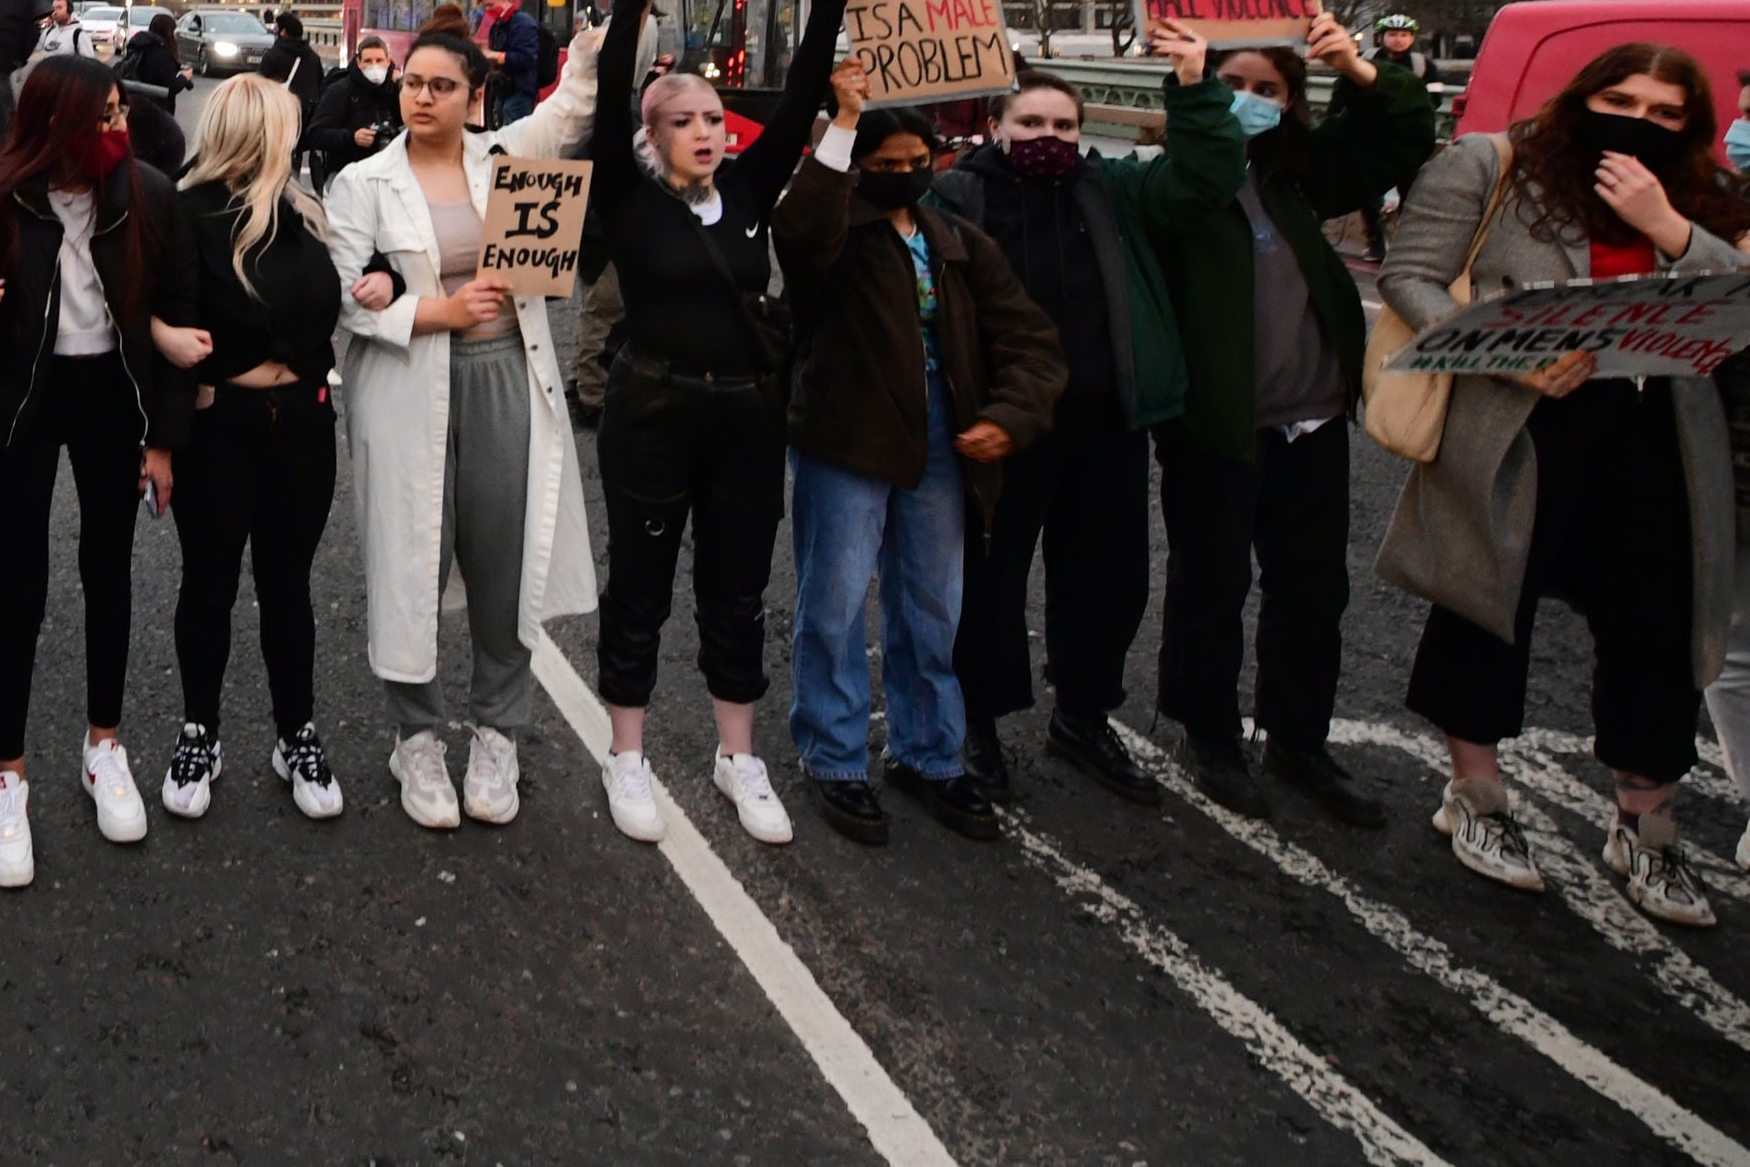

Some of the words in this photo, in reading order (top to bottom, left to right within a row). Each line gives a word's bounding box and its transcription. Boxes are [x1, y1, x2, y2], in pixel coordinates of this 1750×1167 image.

[846, 2, 893, 43] IS
[898, 2, 923, 37] A
[856, 31, 1009, 94] PROBLEM
[494, 165, 584, 201] ENOUGH
[504, 200, 562, 240] IS
[482, 243, 578, 280] ENOUGH
